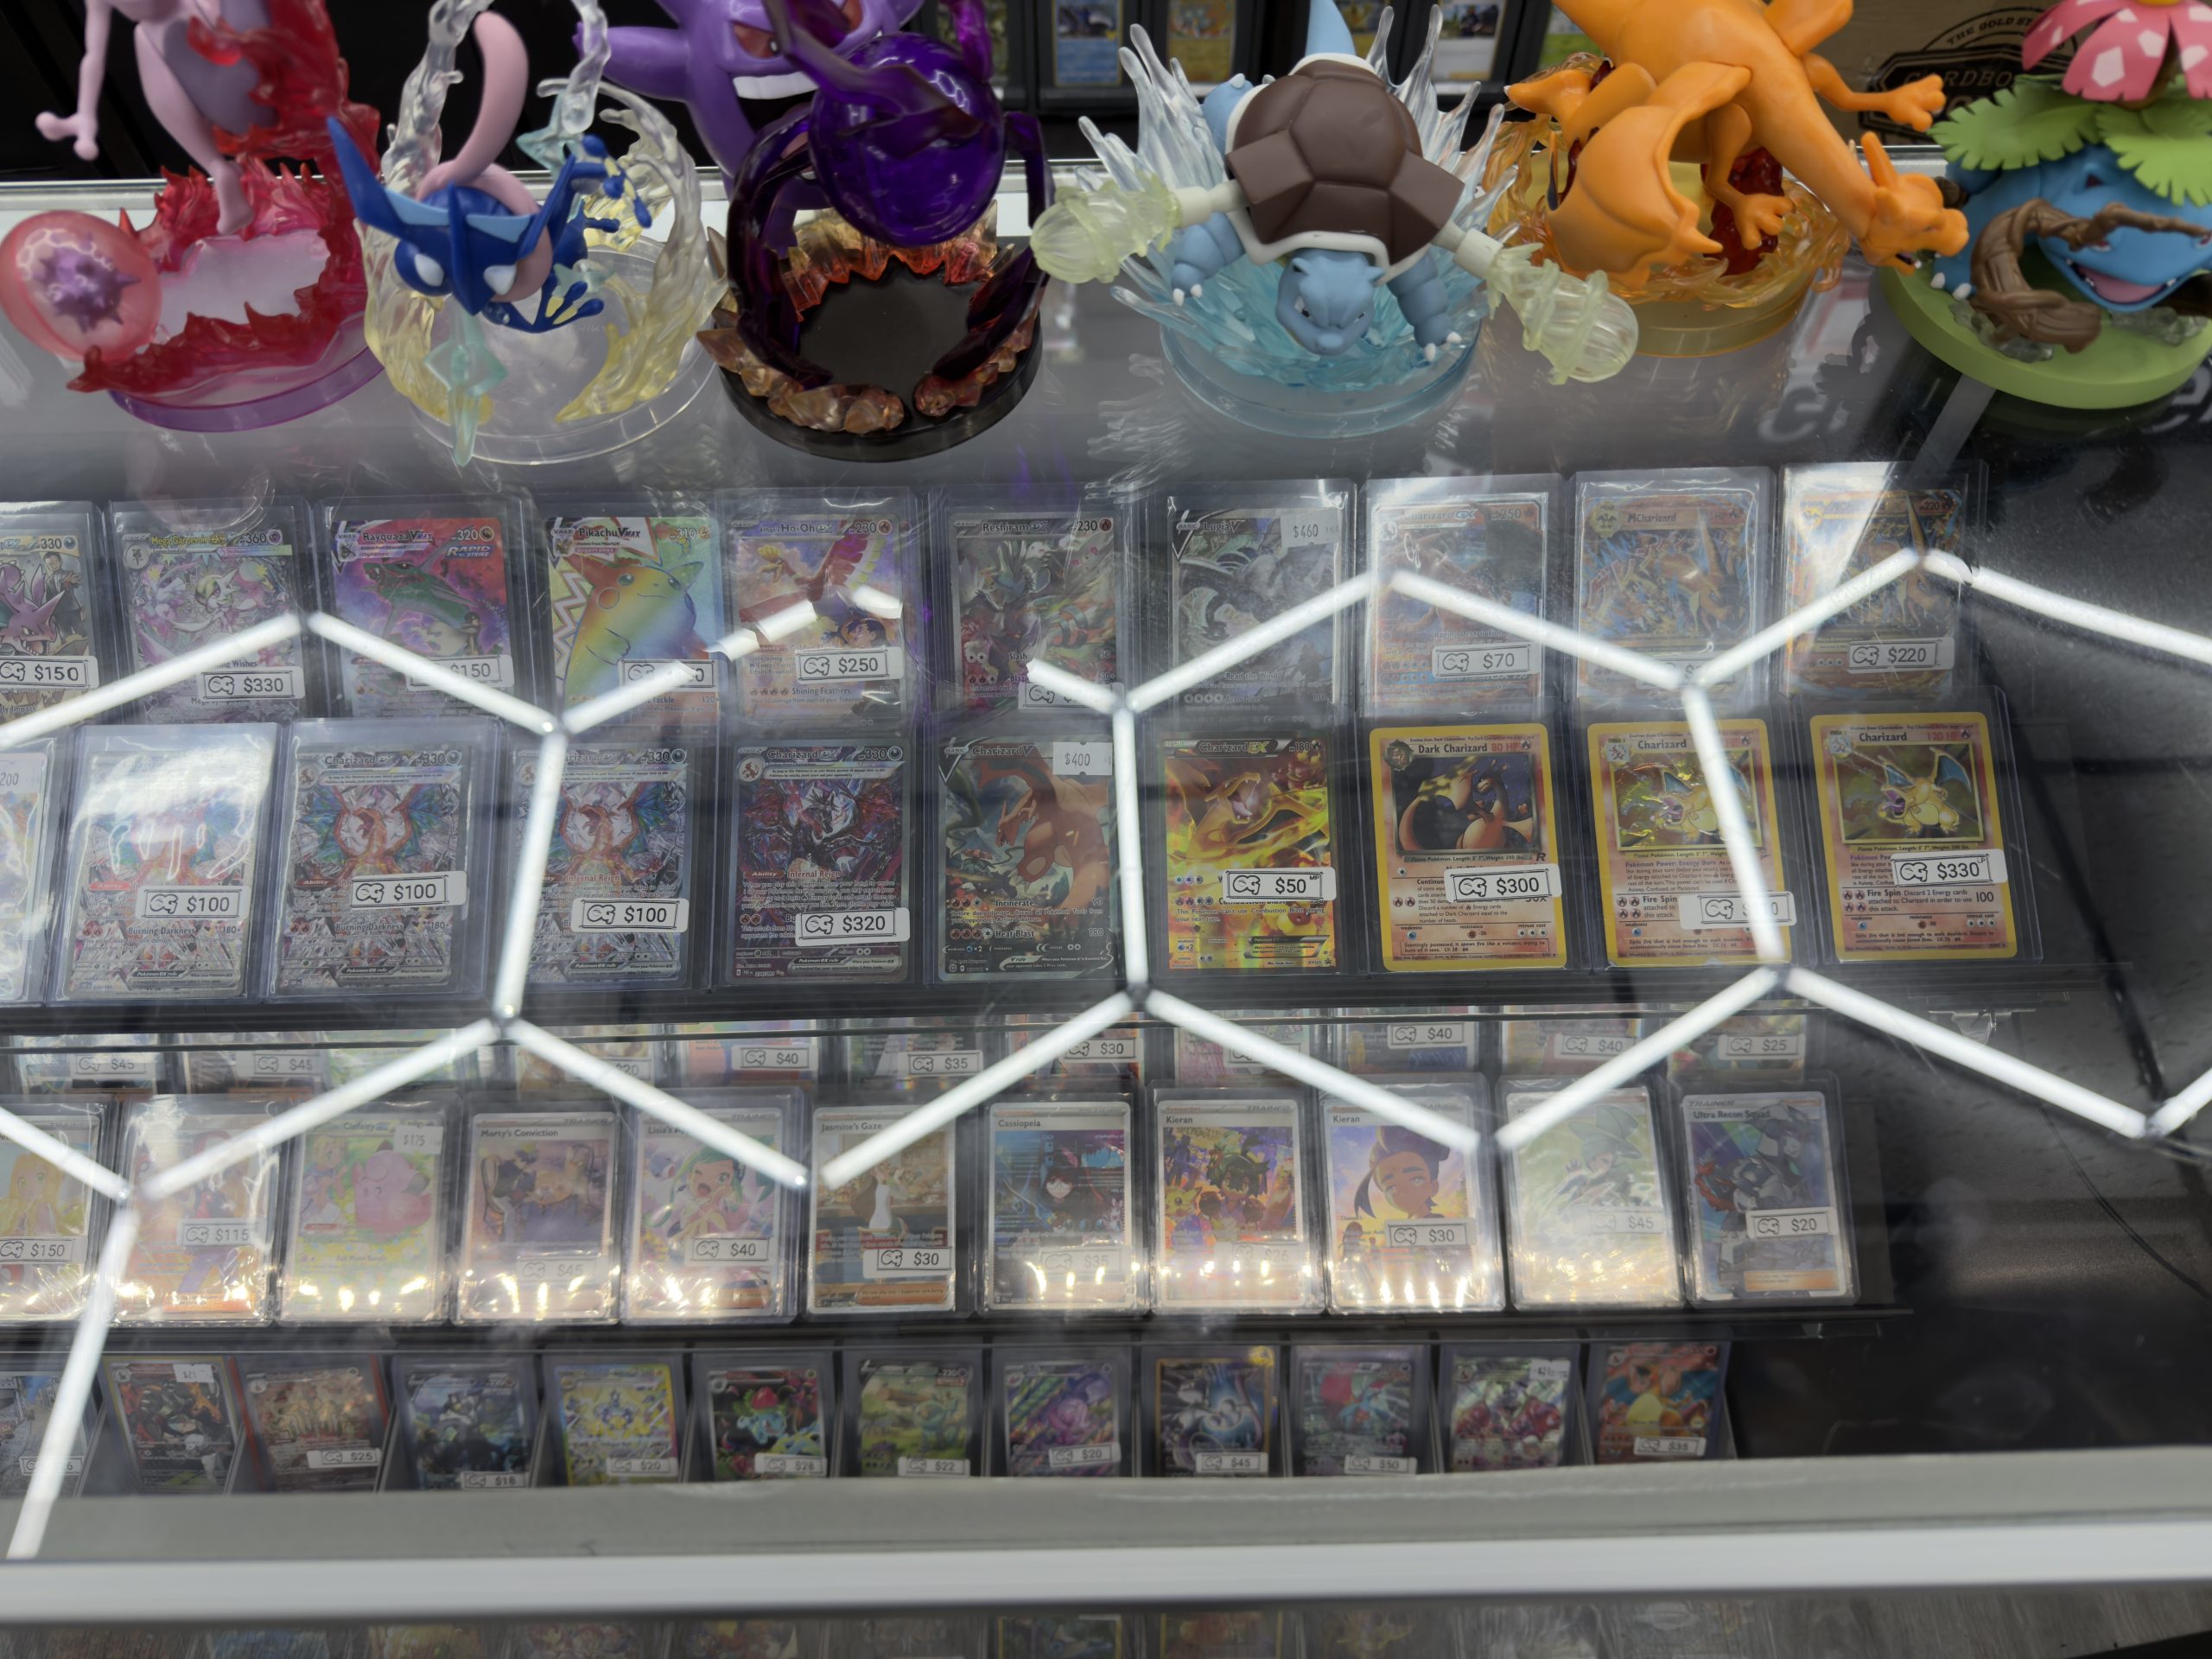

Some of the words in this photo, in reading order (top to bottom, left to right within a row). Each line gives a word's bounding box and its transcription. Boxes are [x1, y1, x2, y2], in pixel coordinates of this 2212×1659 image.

[1946, 28, 1974, 45] THE
[1979, 17, 2014, 31] GOLD
[579, 527, 618, 537] Pikachu
[781, 523, 816, 534] Ho-Oh
[855, 522, 877, 534] 230
[982, 522, 1028, 533] Reshiram
[1203, 520, 1230, 532] Lugia
[1293, 524, 1319, 537] $460
[245, 532, 267, 544] 360
[363, 532, 410, 543] Rayquaza
[456, 529, 479, 541] 320
[41, 537, 62, 550] 330
[447, 545, 491, 555] RAPID
[1009, 652, 1028, 661] Slash
[1483, 653, 1515, 670] $70
[1888, 648, 1926, 664] $220
[838, 657, 878, 674] $250
[35, 665, 79, 683] $150
[244, 677, 283, 694] $330
[1859, 732, 1908, 741] Charizard
[972, 745, 1023, 756] Charizard
[1199, 741, 1248, 753] Charizard
[1419, 744, 1440, 753] Dark
[1443, 743, 1488, 753] Charizard
[1491, 743, 1503, 752] 80
[1637, 740, 1687, 750] Charizard
[423, 753, 446, 765] 330
[648, 752, 671, 762] 330
[767, 749, 819, 760] Charizard
[864, 748, 888, 760] 330
[1065, 753, 1090, 766] $400
[325, 755, 375, 766] Charizard
[820, 870, 841, 880] Reign
[1937, 862, 1980, 880] $330
[565, 874, 597, 883] Infernal
[598, 874, 620, 885] Reign
[394, 883, 436, 901] $100
[1275, 878, 1306, 894] $50
[1497, 877, 1540, 895] $300
[995, 899, 1034, 907] Incinerate
[1092, 897, 1104, 906] 90
[1643, 895, 1659, 904] Fire
[1660, 895, 1678, 904] Spin
[1975, 892, 1994, 903] 100
[187, 895, 230, 913] $100
[624, 906, 667, 924] $100
[335, 923, 368, 932] Burning
[368, 923, 403, 931] Darkness
[843, 915, 886, 933] $320
[128, 926, 159, 936] Burning
[161, 926, 195, 935] Darkness
[995, 930, 1013, 938] Heat
[1015, 930, 1035, 938] Blast
[1089, 928, 1104, 938] 180
[1427, 1027, 1452, 1040] $40
[1101, 1042, 1124, 1056] $30
[1599, 1039, 1623, 1052] $40
[1763, 1039, 1787, 1052] $25
[111, 1058, 135, 1070] $45
[289, 1058, 313, 1071] $45
[776, 1052, 798, 1065] $40
[945, 1058, 969, 1071] $35
[1166, 1115, 1193, 1124] Kieran
[1332, 1115, 1360, 1123] Kieran
[1694, 1111, 1715, 1120] Ultra
[1718, 1111, 1744, 1120] Recon
[648, 1125, 673, 1135] Lisia's
[821, 1122, 860, 1133] Jasmine's
[861, 1122, 882, 1131] Gaze
[998, 1119, 1041, 1129] Cassiopeia
[514, 1128, 558, 1138] Conviction
[1628, 1215, 1655, 1230] $45
[1790, 1218, 1818, 1232] $20
[215, 1227, 251, 1243] $115
[1429, 1229, 1455, 1243] $30
[31, 1243, 66, 1258] $150
[731, 1243, 757, 1257] $40
[914, 1251, 939, 1266] $30
[1084, 1253, 1109, 1268] $35
[557, 1263, 584, 1277] $45
[351, 1452, 372, 1462] $25
[1082, 1449, 1103, 1459] $20
[1230, 1457, 1251, 1468] $45
